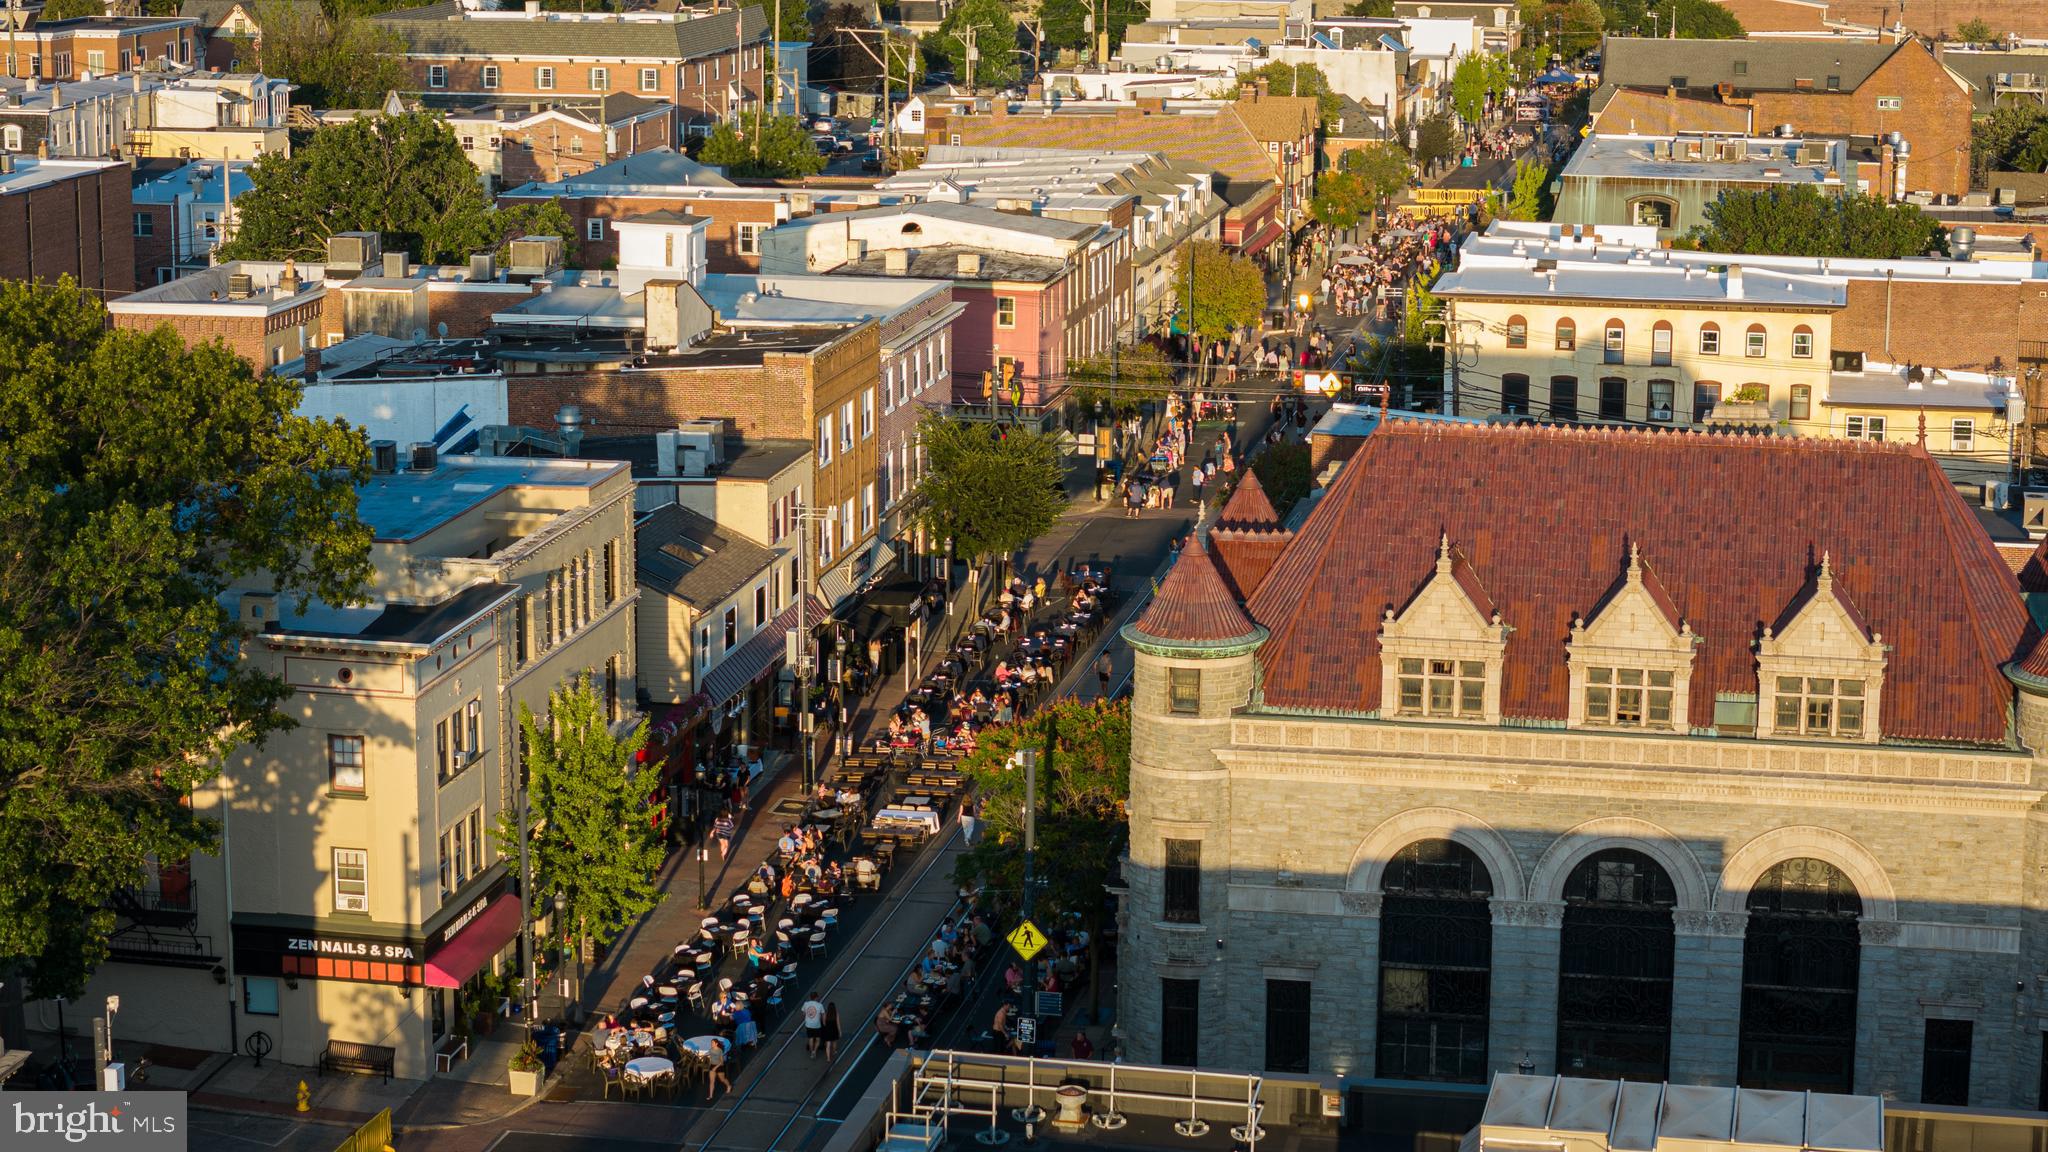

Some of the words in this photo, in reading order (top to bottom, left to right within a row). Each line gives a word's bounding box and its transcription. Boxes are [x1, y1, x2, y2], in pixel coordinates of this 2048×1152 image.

[288, 938, 318, 951] ZEN
[321, 940, 366, 955] NAILS
[370, 945, 381, 956] &
[384, 946, 413, 959] SPA
